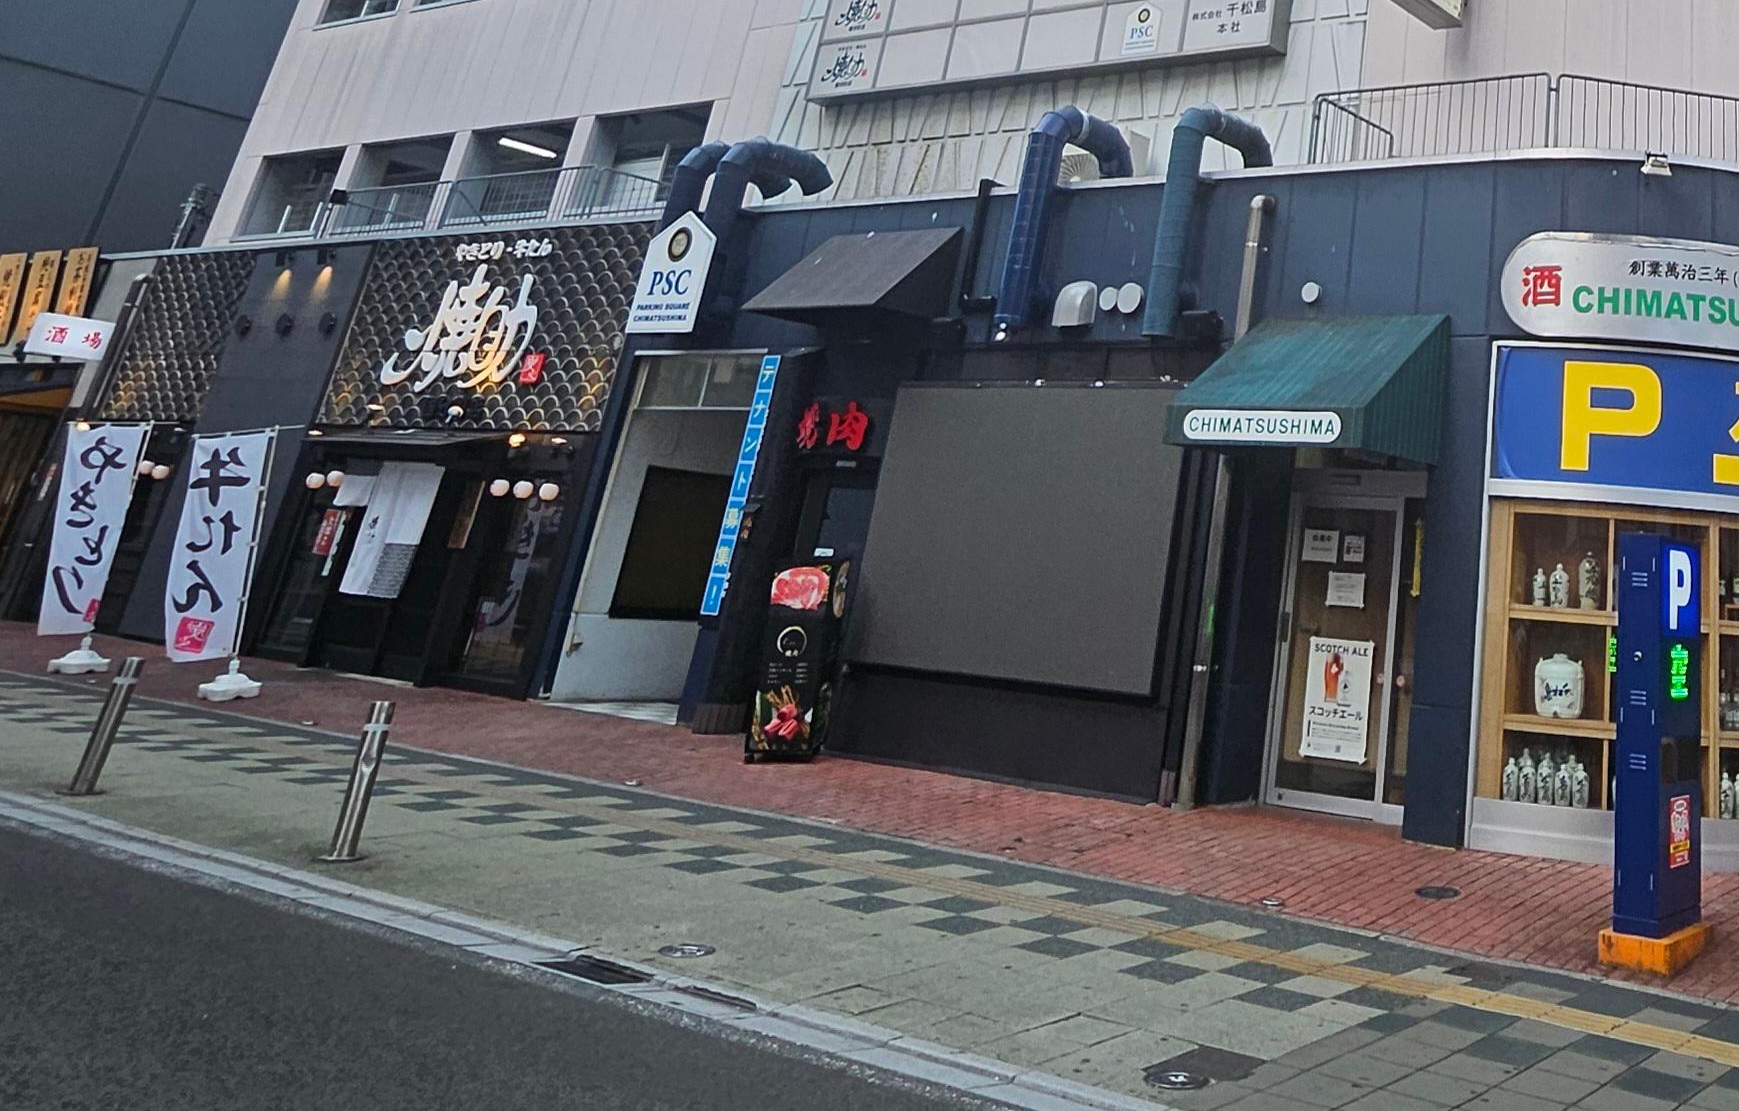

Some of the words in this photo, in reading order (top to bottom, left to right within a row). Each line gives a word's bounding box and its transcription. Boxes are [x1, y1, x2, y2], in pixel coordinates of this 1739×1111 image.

[1192, 9, 1222, 22] 株式会社
[1130, 25, 1154, 40] PSC
[1217, 20, 1241, 35] 本社
[647, 268, 693, 297] PSC
[1521, 265, 1563, 308] 酒
[637, 303, 664, 311] PARKING
[665, 302, 690, 310] SQUARE
[633, 314, 688, 322] CHIMATSUSHIMA
[45, 325, 102, 350] 酒場
[1559, 359, 1663, 472] P
[1188, 415, 1336, 437] CHIMATSUSHIMA
[1668, 549, 1693, 631] P
[1314, 643, 1350, 656] SCOTCH
[1351, 647, 1369, 658] ALE
[1309, 705, 1363, 722] スコッチエール
